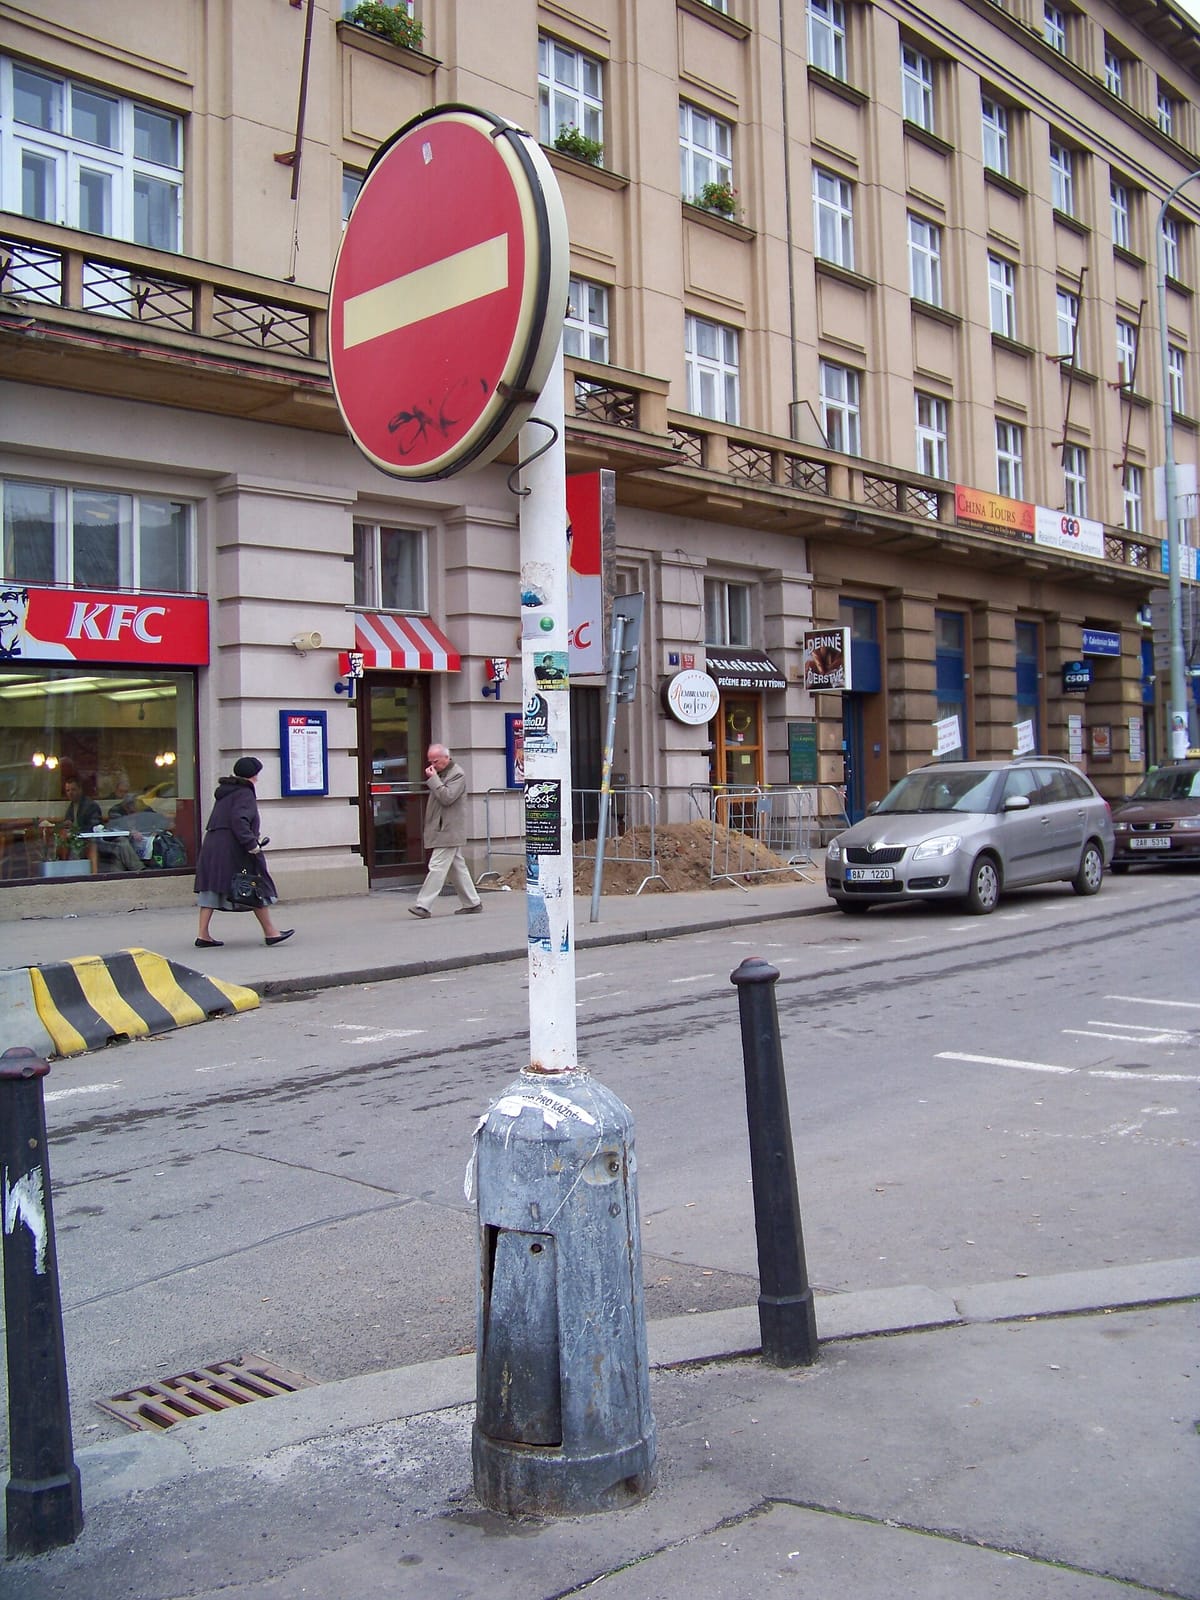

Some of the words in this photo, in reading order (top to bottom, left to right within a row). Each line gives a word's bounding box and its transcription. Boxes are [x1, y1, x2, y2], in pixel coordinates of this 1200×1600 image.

[957, 494, 987, 517] CHINA
[988, 500, 1017, 524] TOURS
[66, 601, 167, 644] KFC
[808, 633, 842, 654] DENNĚ
[705, 658, 778, 672] PEKAŘSTVÍ
[718, 675, 739, 687] PEČEME
[291, 717, 305, 725] KFC
[852, 870, 865, 879] 8A7
[871, 869, 890, 879] 1220
[535, 1094, 553, 1107] PRO
